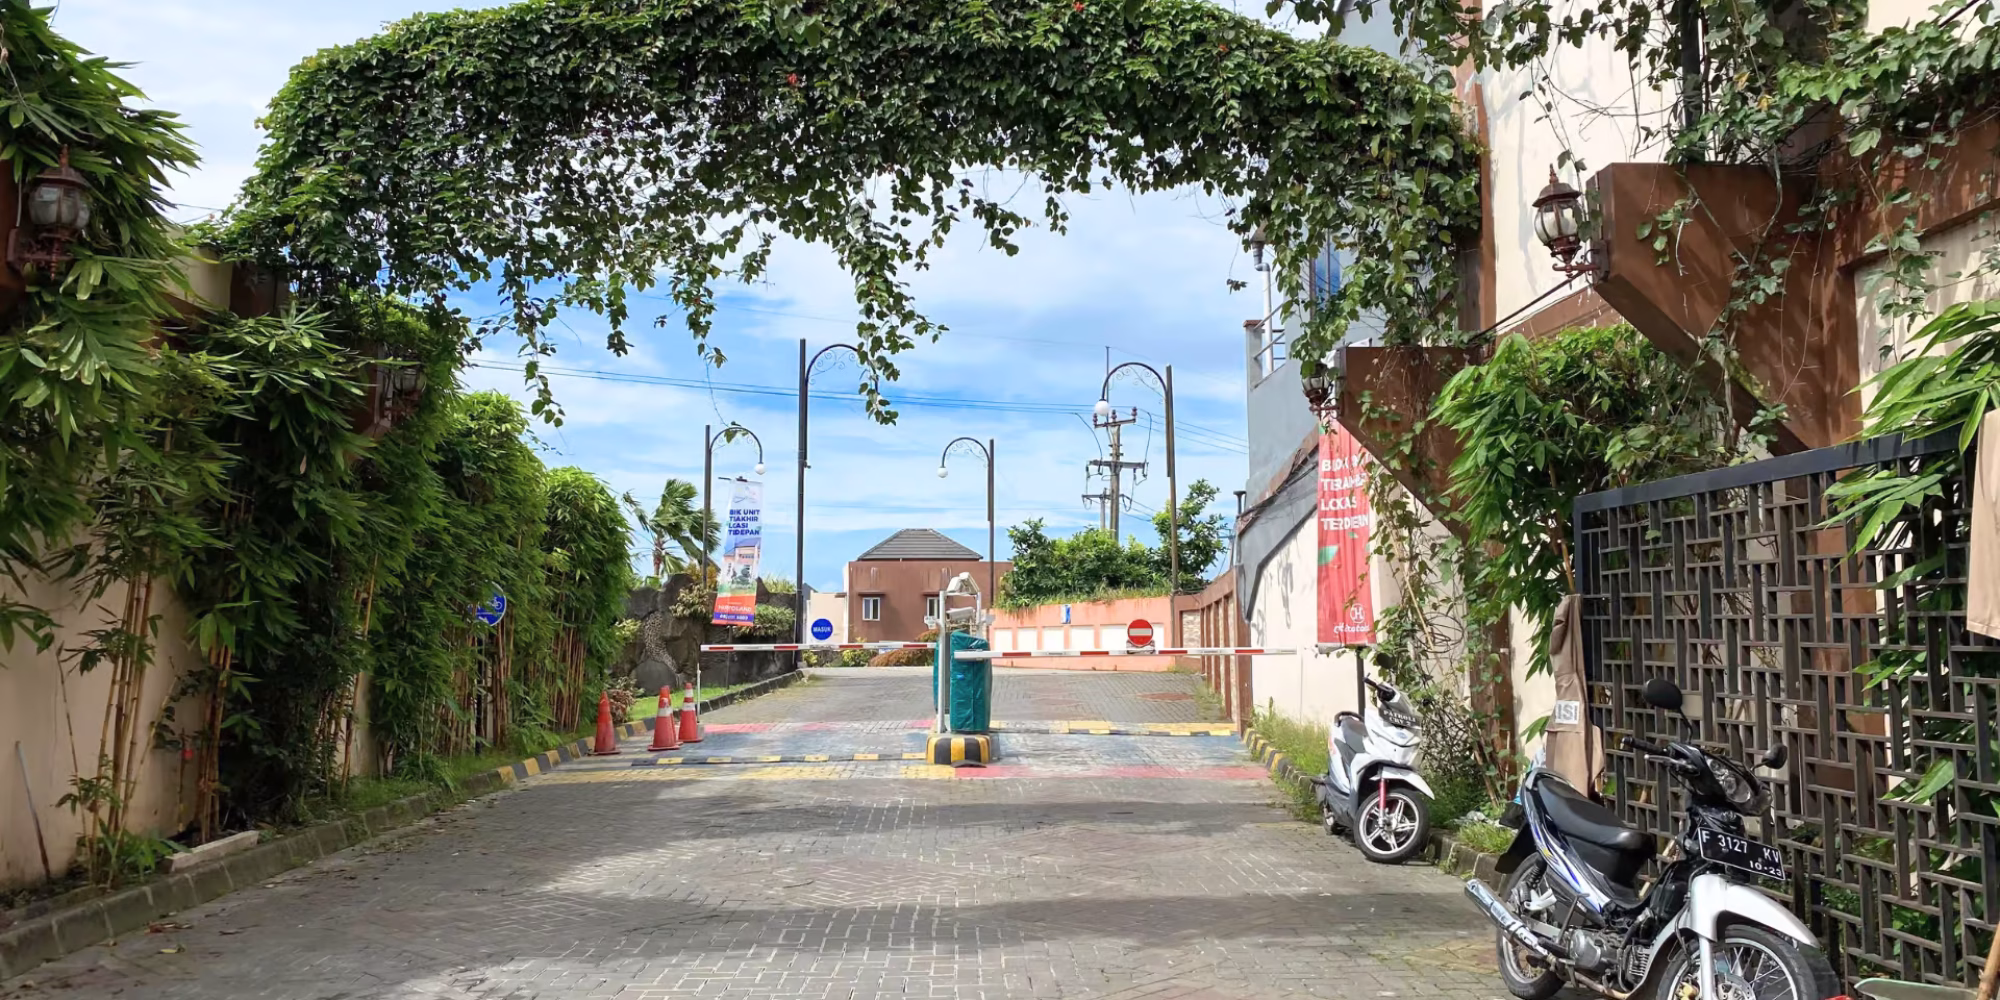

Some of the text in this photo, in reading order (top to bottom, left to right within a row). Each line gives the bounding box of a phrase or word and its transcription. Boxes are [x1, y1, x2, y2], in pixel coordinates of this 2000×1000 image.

[1701, 830, 1780, 864] F 3127 KV
